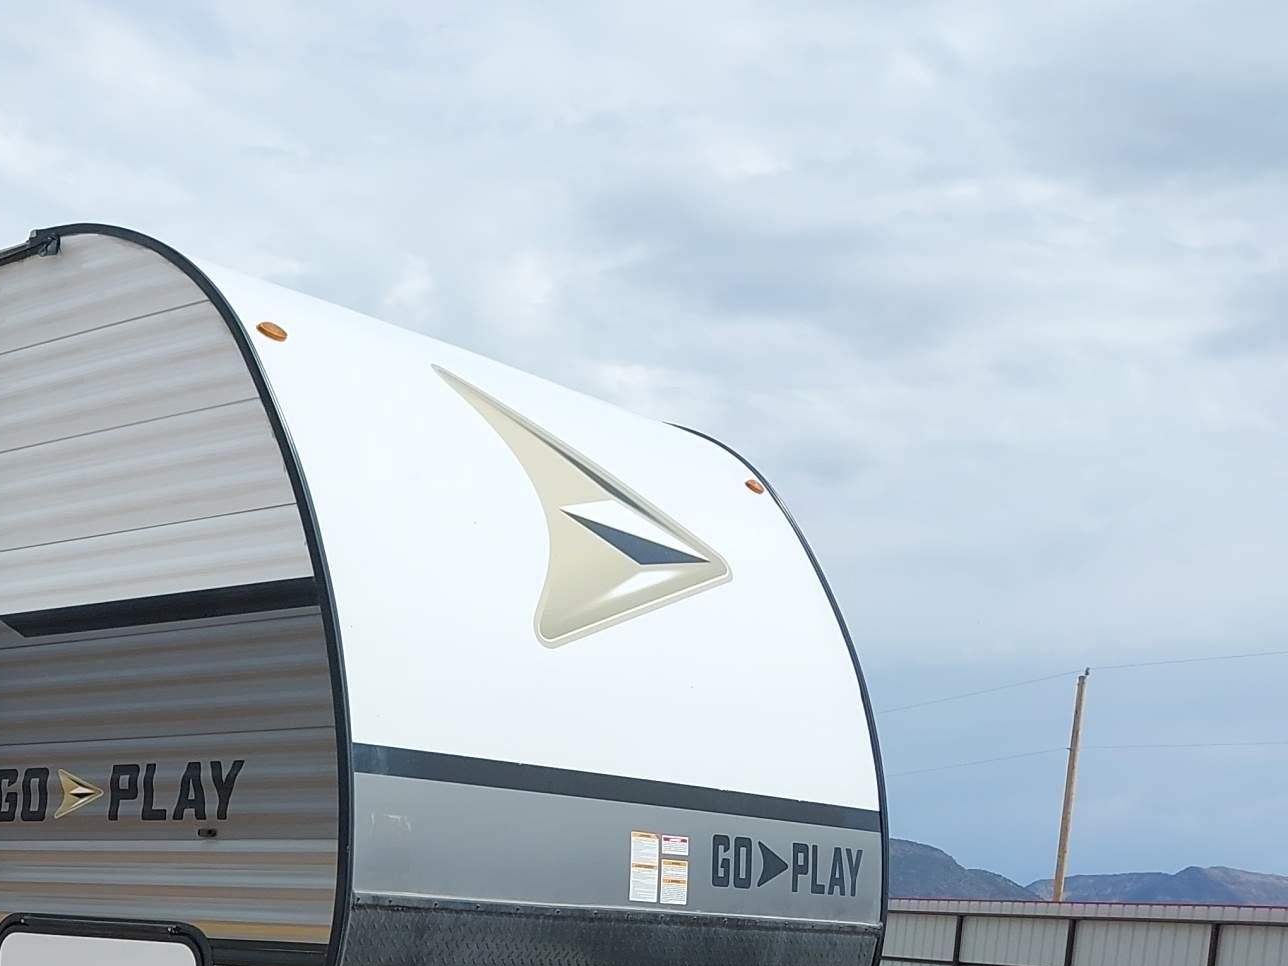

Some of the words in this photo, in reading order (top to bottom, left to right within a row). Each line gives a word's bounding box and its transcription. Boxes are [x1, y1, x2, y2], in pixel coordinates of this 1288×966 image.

[107, 759, 245, 821] PLAY
[712, 834, 753, 890] GO
[791, 842, 863, 897] PLAY
